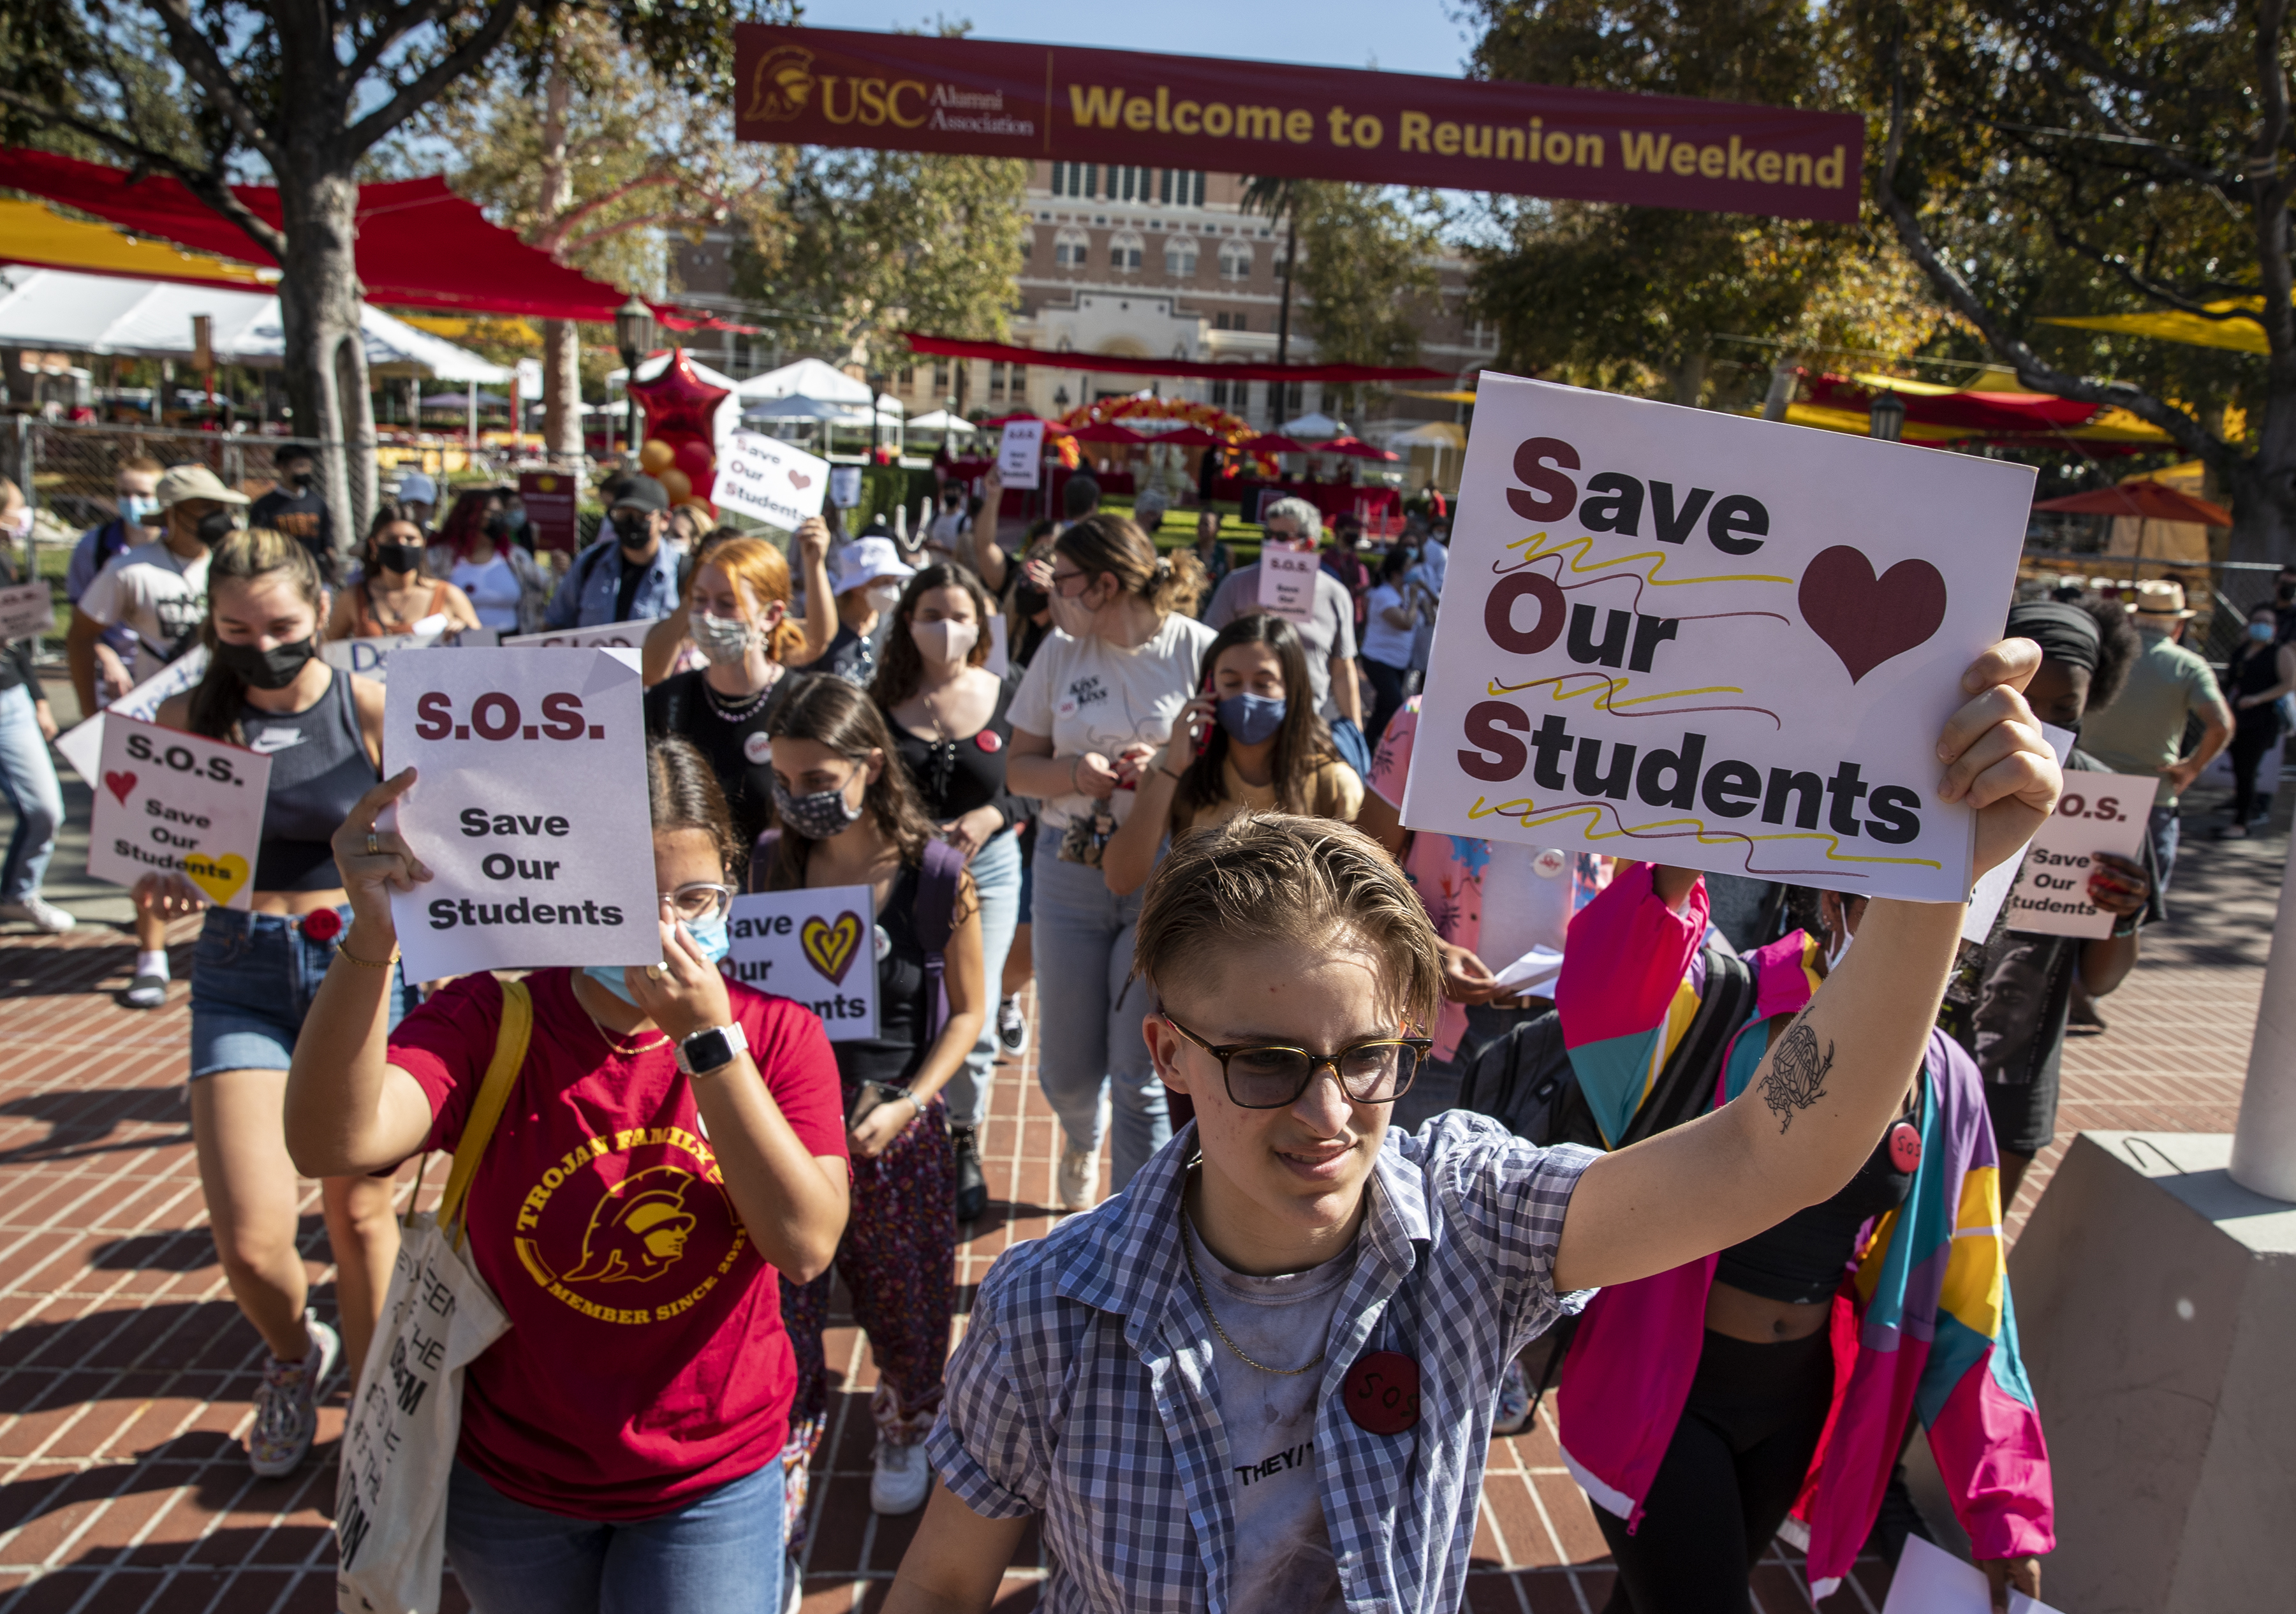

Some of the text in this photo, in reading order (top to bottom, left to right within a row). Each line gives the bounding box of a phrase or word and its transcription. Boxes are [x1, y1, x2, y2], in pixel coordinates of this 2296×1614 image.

[819, 75, 928, 129] USC
[930, 83, 1003, 111] Alumni
[929, 107, 1035, 137] Association
[1069, 84, 1846, 189] Welcome to Reunion Weekend
[737, 436, 781, 464] Save
[731, 460, 763, 481] Our
[1506, 436, 1770, 555] Save
[1483, 571, 1679, 673] Our
[415, 691, 605, 740] S.O.S.
[126, 734, 244, 786] S.O.S.
[1457, 700, 1922, 845] Students
[145, 799, 211, 829] Save
[460, 807, 570, 837] Save
[151, 827, 200, 850] Our
[115, 839, 232, 881] Students
[482, 853, 560, 880] Our
[2033, 849, 2091, 868] Save
[2035, 873, 2075, 891] Our
[429, 897, 624, 929] Students
[2012, 895, 2098, 916] tudents
[728, 914, 793, 939] ave
[516, 1126, 716, 1232] TROJAN FAMILY
[547, 1281, 652, 1325] MEMBER
[655, 1275, 719, 1321] SINCE
[1358, 1372, 1420, 1418] SOS
